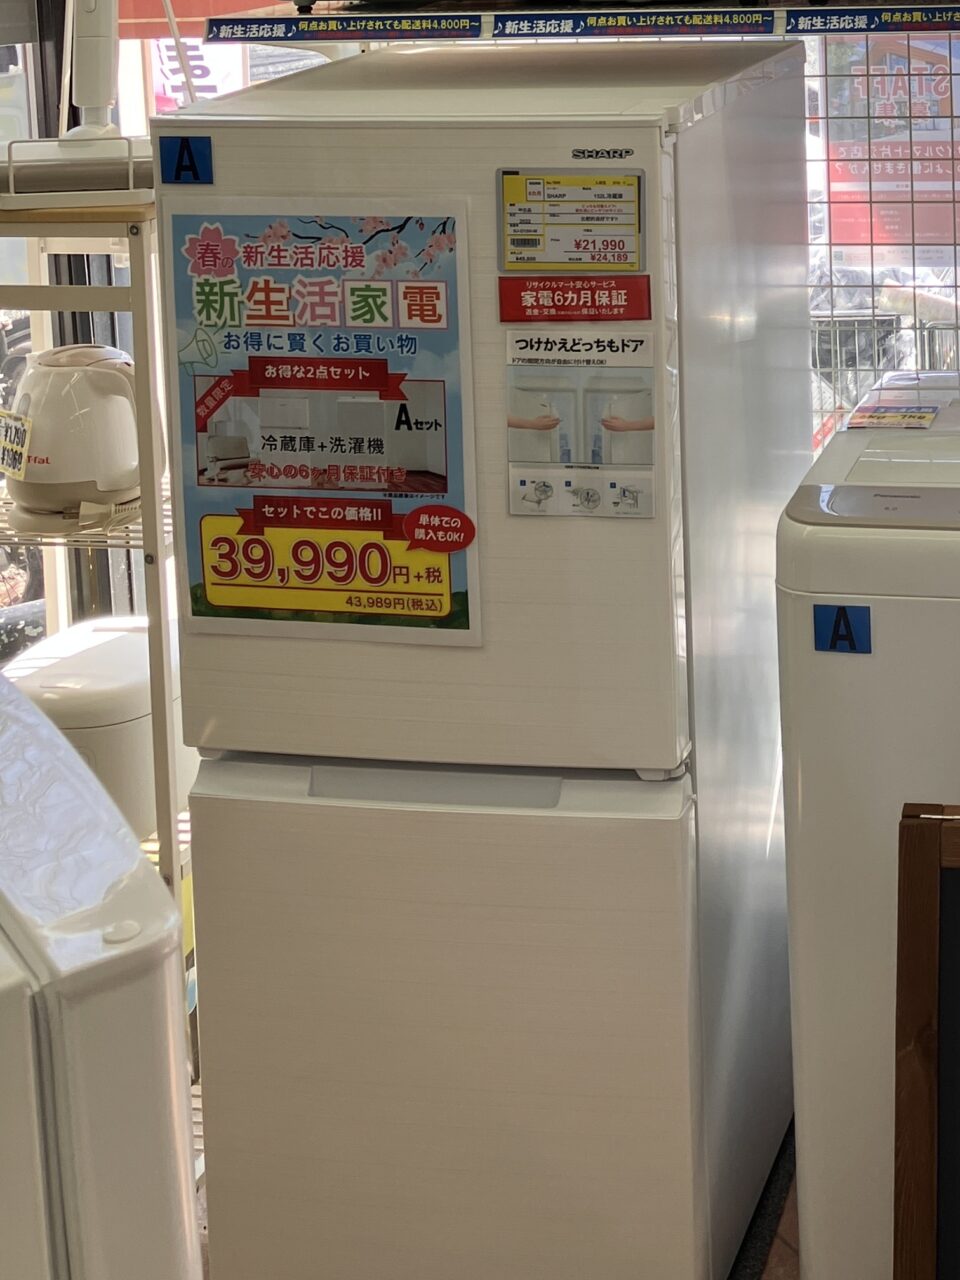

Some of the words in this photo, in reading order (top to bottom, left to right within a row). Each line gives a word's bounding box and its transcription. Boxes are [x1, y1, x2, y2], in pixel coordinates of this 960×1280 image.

[505, 19, 573, 35] 新生活応援
[798, 15, 868, 30] 新生活応援
[220, 24, 286, 39] 新生活応援
[174, 136, 200, 181] A
[572, 149, 634, 159] SHARP
[574, 239, 625, 252] ¥21,990
[196, 242, 234, 269] 春の
[242, 244, 365, 269] 新生活応援
[590, 253, 628, 263] ¥24,189
[526, 280, 616, 289] リサイクルマート安心サービス
[195, 277, 444, 326] 新生活家電
[521, 290, 627, 307] 家電6カ月保証
[223, 331, 418, 355] お得に賢くお買い物
[515, 337, 644, 353] つけかえどっちもドア
[264, 365, 370, 379] お得な2点セット
[196, 378, 234, 418] 数量限定
[394, 403, 442, 431] Aセット
[260, 435, 385, 455] 冷蔵庫+洗濯機
[418, 513, 461, 528] 単体での
[414, 528, 464, 543] 購入もOK!
[345, 596, 443, 613] 43,989円(税込)
[829, 607, 857, 651] A
